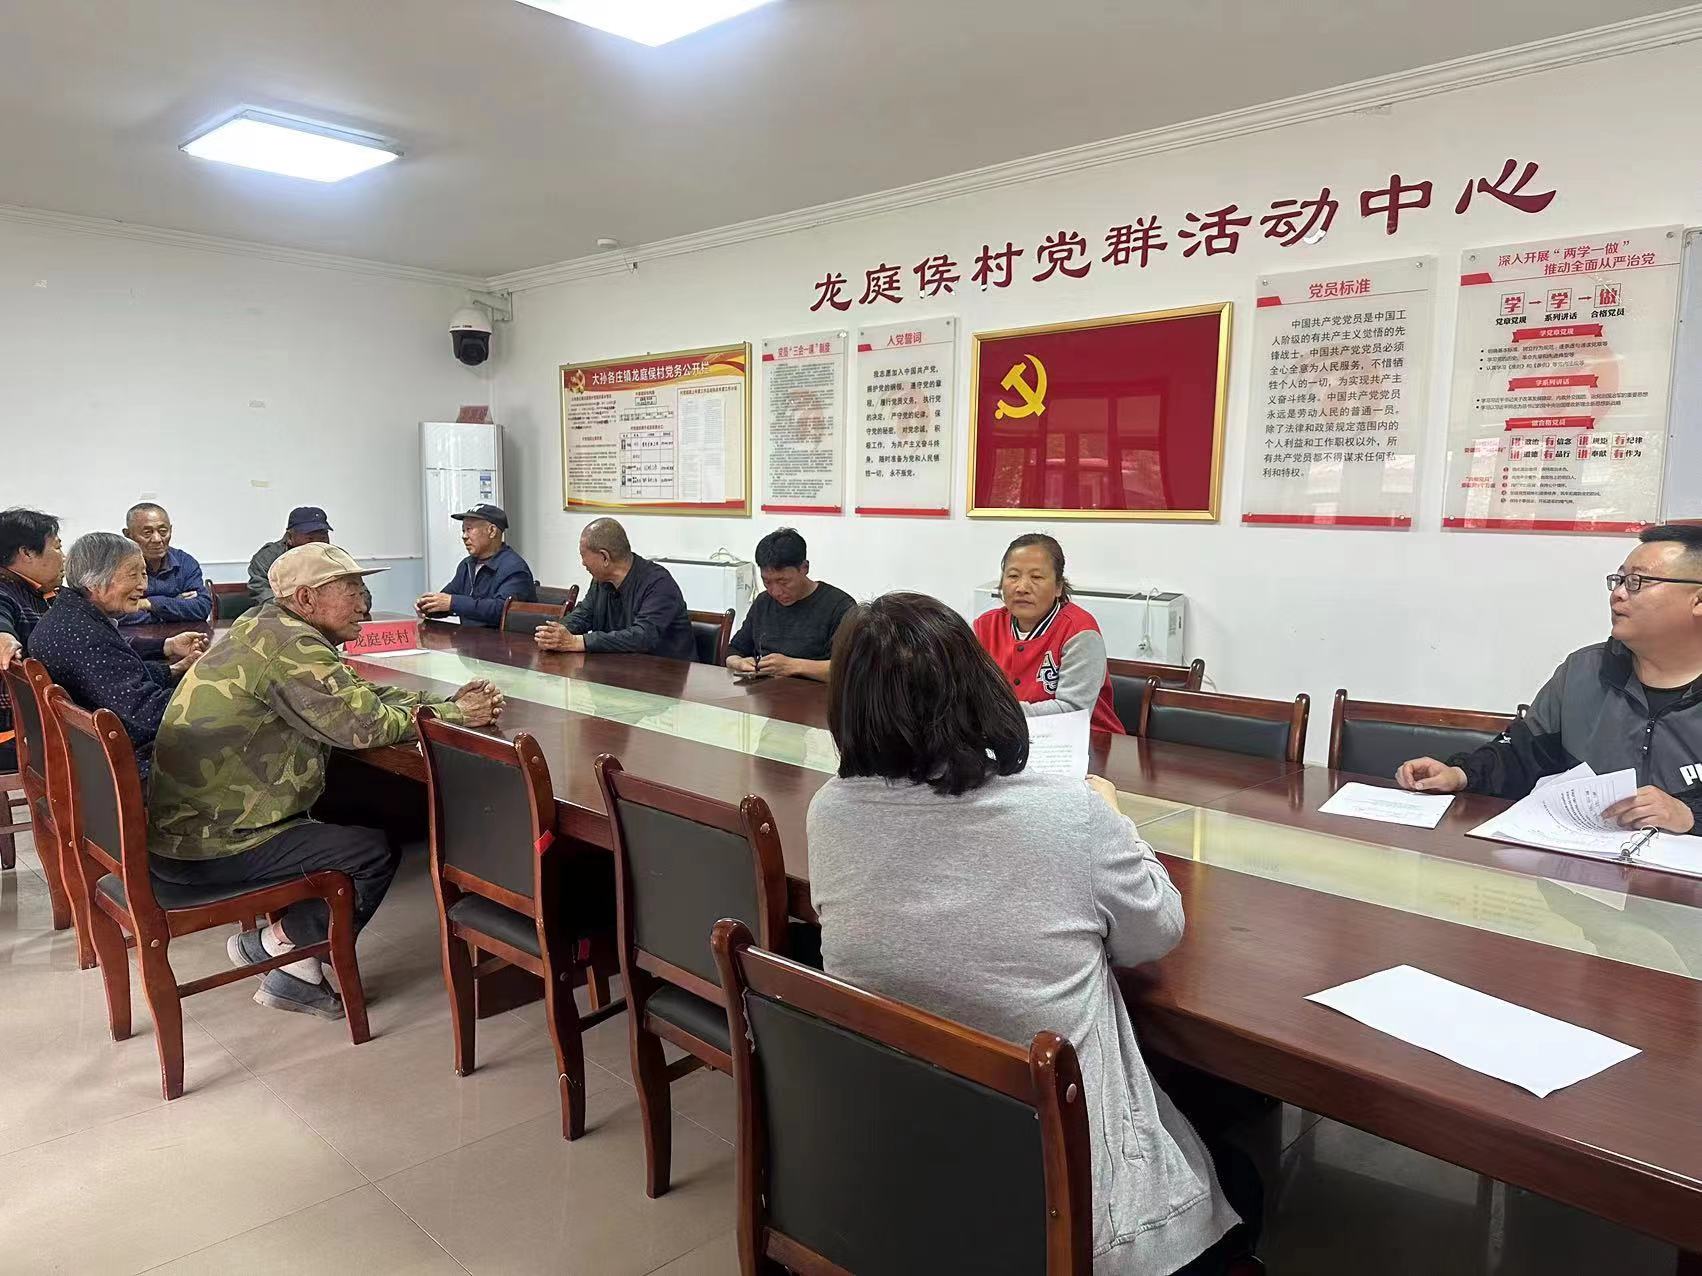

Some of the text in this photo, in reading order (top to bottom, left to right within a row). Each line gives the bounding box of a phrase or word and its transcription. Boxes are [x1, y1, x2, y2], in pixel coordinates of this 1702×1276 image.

[809, 158, 1556, 312] 龙庭侯村党群活动中心
[1544, 252, 1655, 276] 推动全面从严治党
[1309, 278, 1371, 299] 党员标准
[1504, 287, 1618, 313] 学 学 做
[1292, 310, 1406, 329] 中国共产党党员是中国工
[1544, 311, 1577, 322] 系列讲话
[1591, 307, 1625, 318] 合格党员
[887, 332, 922, 346] 入党誓词
[1271, 326, 1406, 346] 人阶级的有共产主义觉悟的先
[1271, 342, 1405, 361] 锋战士。中国共产党党员必须
[1268, 389, 1401, 405] 义奋斗终身。中国共产党党员
[1267, 405, 1399, 419] 永远是劳动人民的普通一员。
[1265, 421, 1399, 434] 除了法律和政策规定范围内的
[1265, 436, 1397, 449] 个人利益和工作职权以外，所
[353, 629, 409, 648] 龙庭侯村
